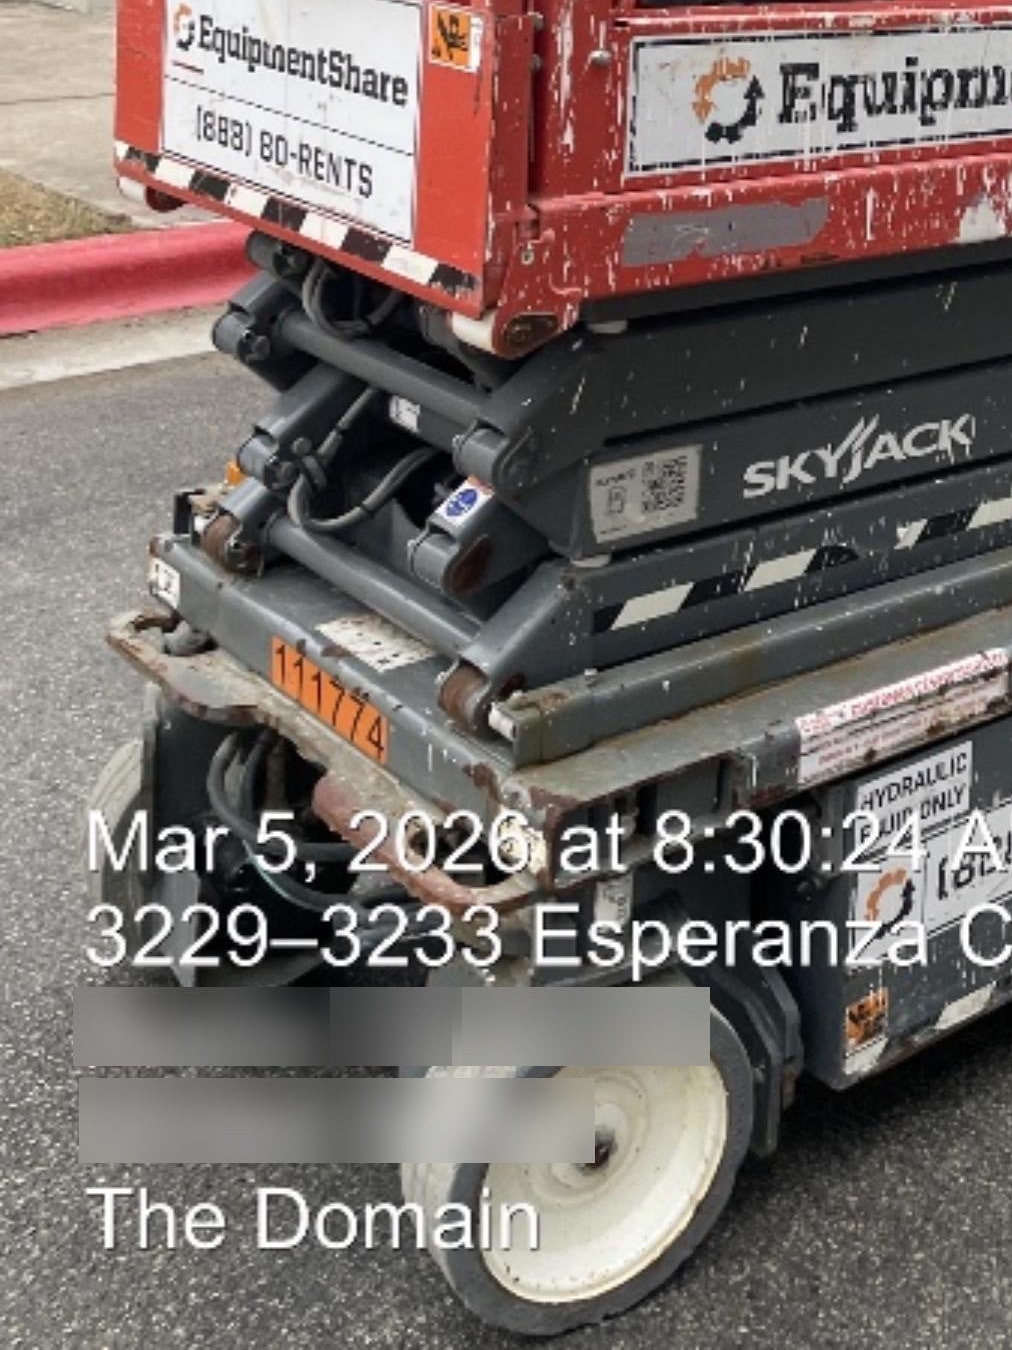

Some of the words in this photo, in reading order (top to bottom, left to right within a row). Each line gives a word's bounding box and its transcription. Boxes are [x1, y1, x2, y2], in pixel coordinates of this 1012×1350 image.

[197, 13, 409, 108] EquipmentShare
[259, 129, 374, 199] 80-RENTS
[743, 412, 973, 500] SKYJACK
[273, 643, 386, 762] 111774
[860, 752, 968, 811] HYDRAULIC
[920, 782, 967, 820] ONLY
